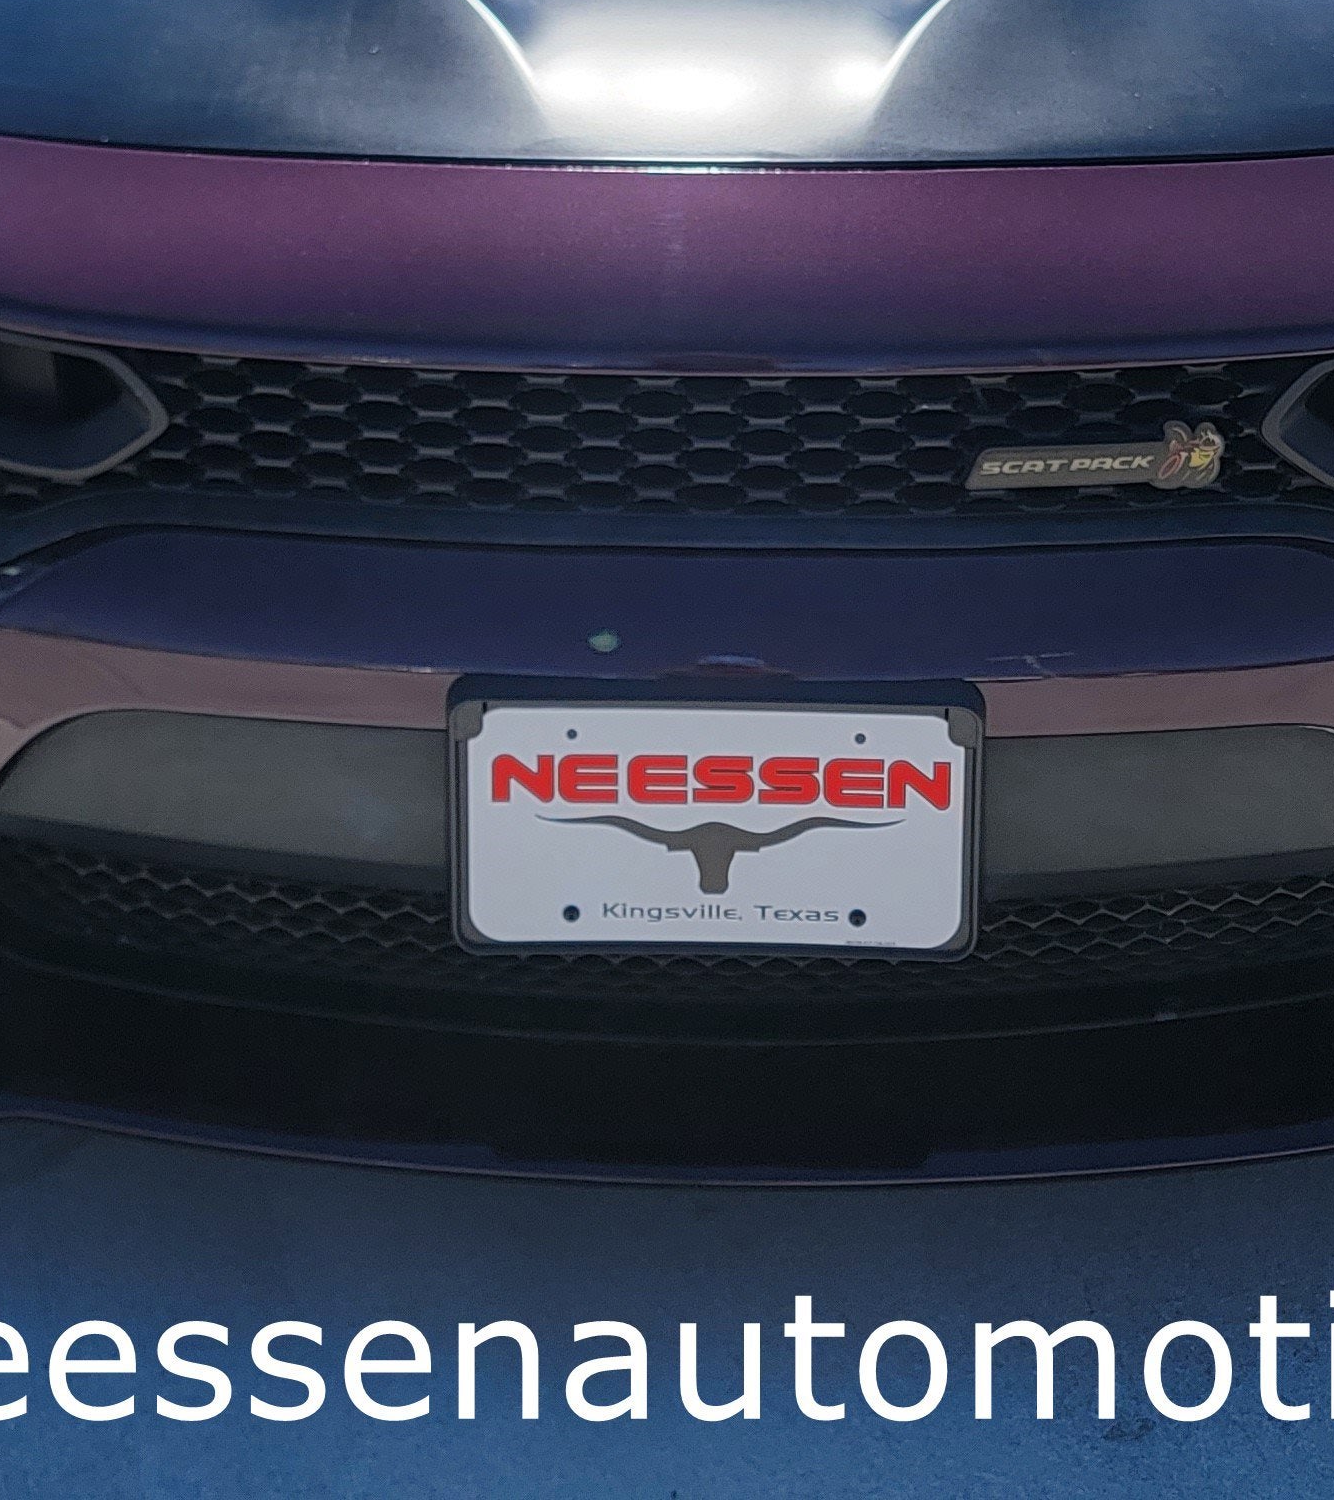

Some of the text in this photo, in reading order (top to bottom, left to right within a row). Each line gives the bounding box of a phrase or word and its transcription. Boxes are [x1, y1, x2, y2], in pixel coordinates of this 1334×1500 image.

[980, 455, 1155, 476] SCAT PACK
[491, 753, 952, 811] NEESSEN
[603, 903, 840, 923] Kingsville, Texas
